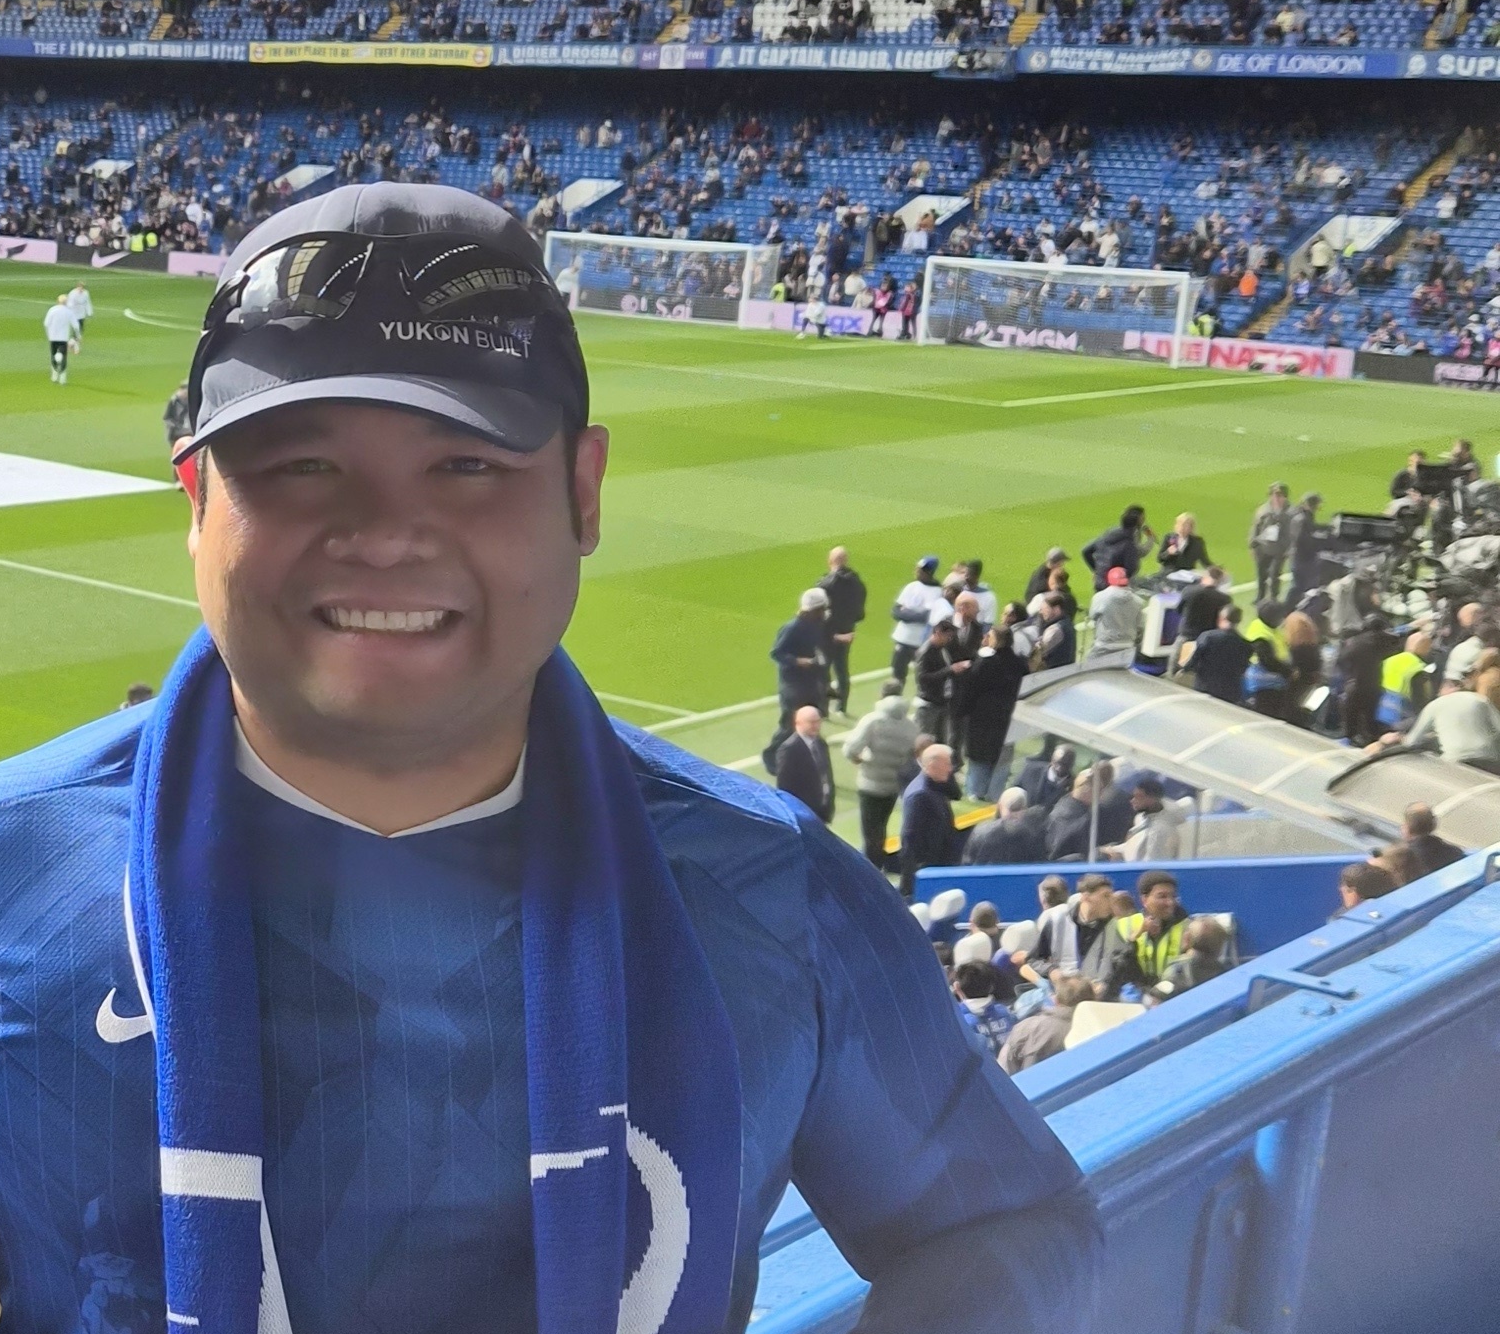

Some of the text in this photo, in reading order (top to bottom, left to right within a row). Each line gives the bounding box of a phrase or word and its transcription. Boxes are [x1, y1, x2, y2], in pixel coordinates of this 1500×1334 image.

[33, 42, 58, 55] THE
[269, 47, 283, 57] THE
[328, 47, 339, 57] TO
[374, 47, 398, 58] EVERY
[400, 47, 425, 59] OTHER
[428, 48, 470, 60] SATURDAY
[513, 47, 619, 59] DIDIER DROGBA
[1246, 53, 1276, 72] OF
[1277, 54, 1366, 74] LONDON
[1436, 54, 1500, 78] SUP
[379, 321, 532, 360] YUKON BUILT
[997, 325, 1079, 351] TMGM
